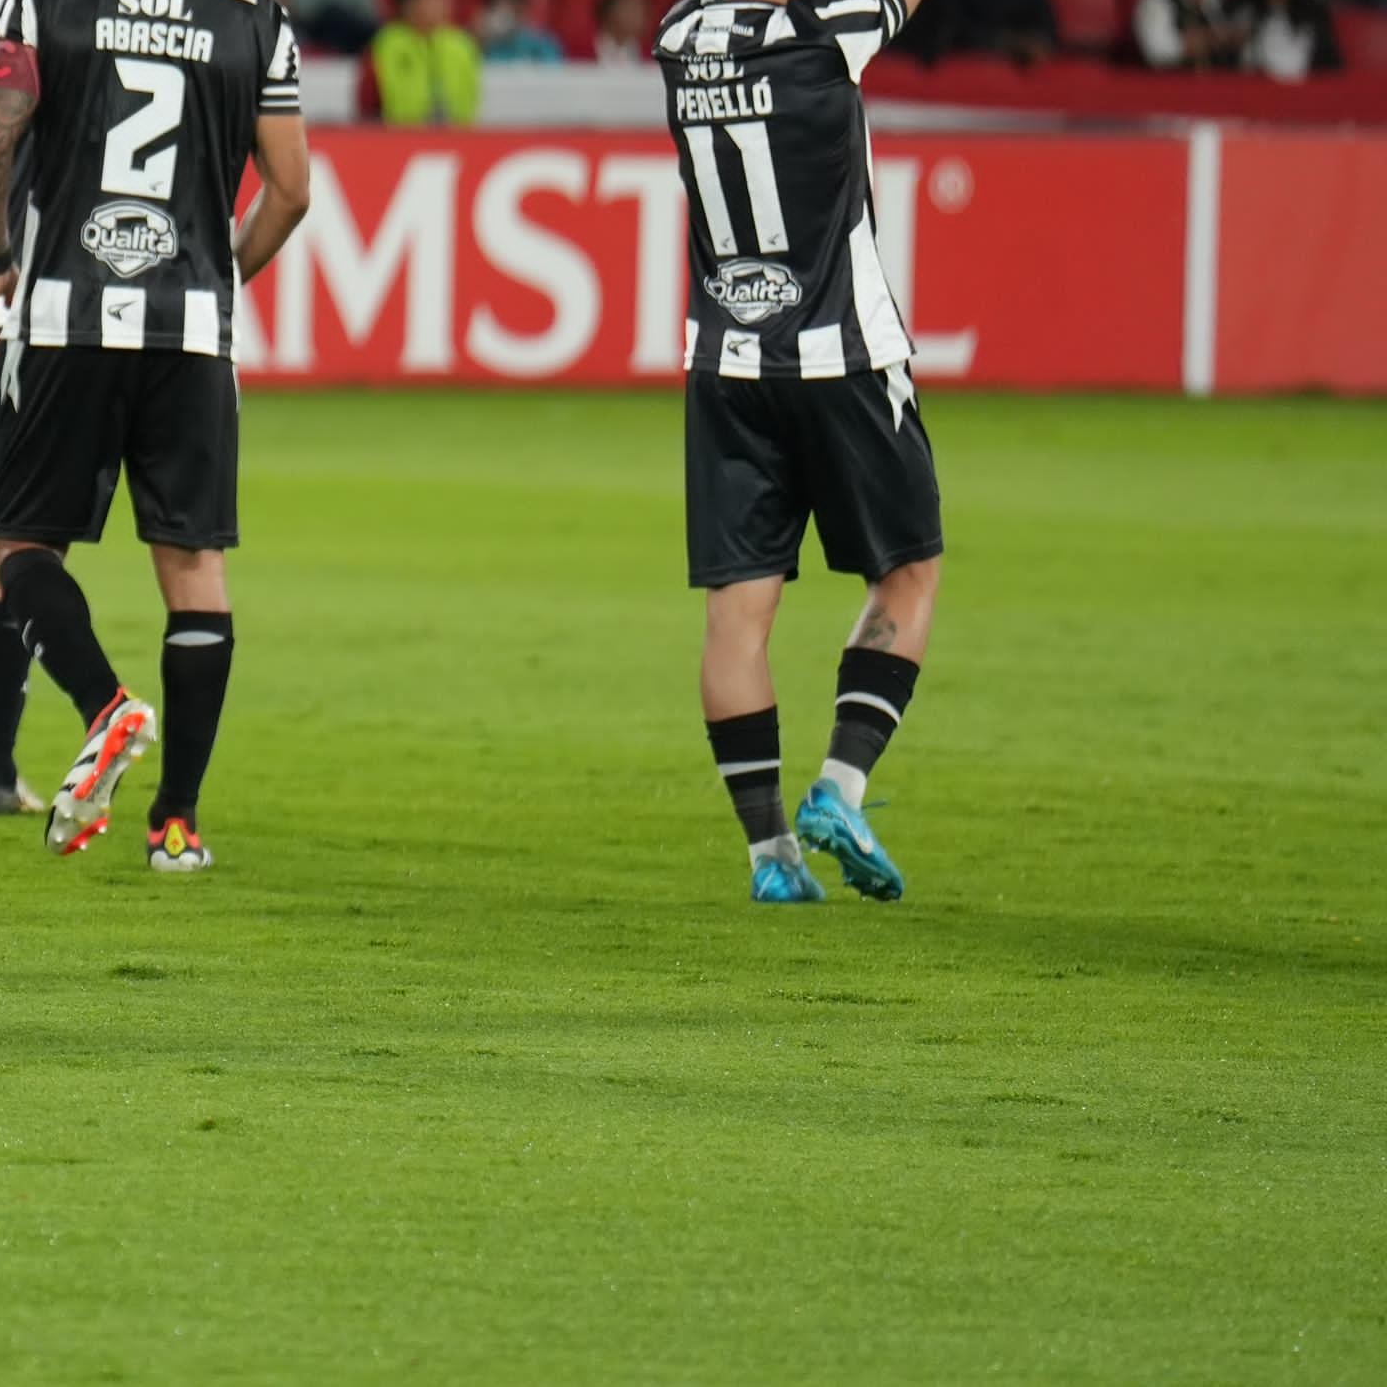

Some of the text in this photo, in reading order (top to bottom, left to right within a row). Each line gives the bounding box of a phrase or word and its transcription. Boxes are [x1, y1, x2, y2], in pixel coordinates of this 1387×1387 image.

[95, 17, 215, 64] ABASCIA
[100, 59, 185, 201] 2
[676, 75, 773, 121] PERELLÓ
[683, 120, 789, 257] 11
